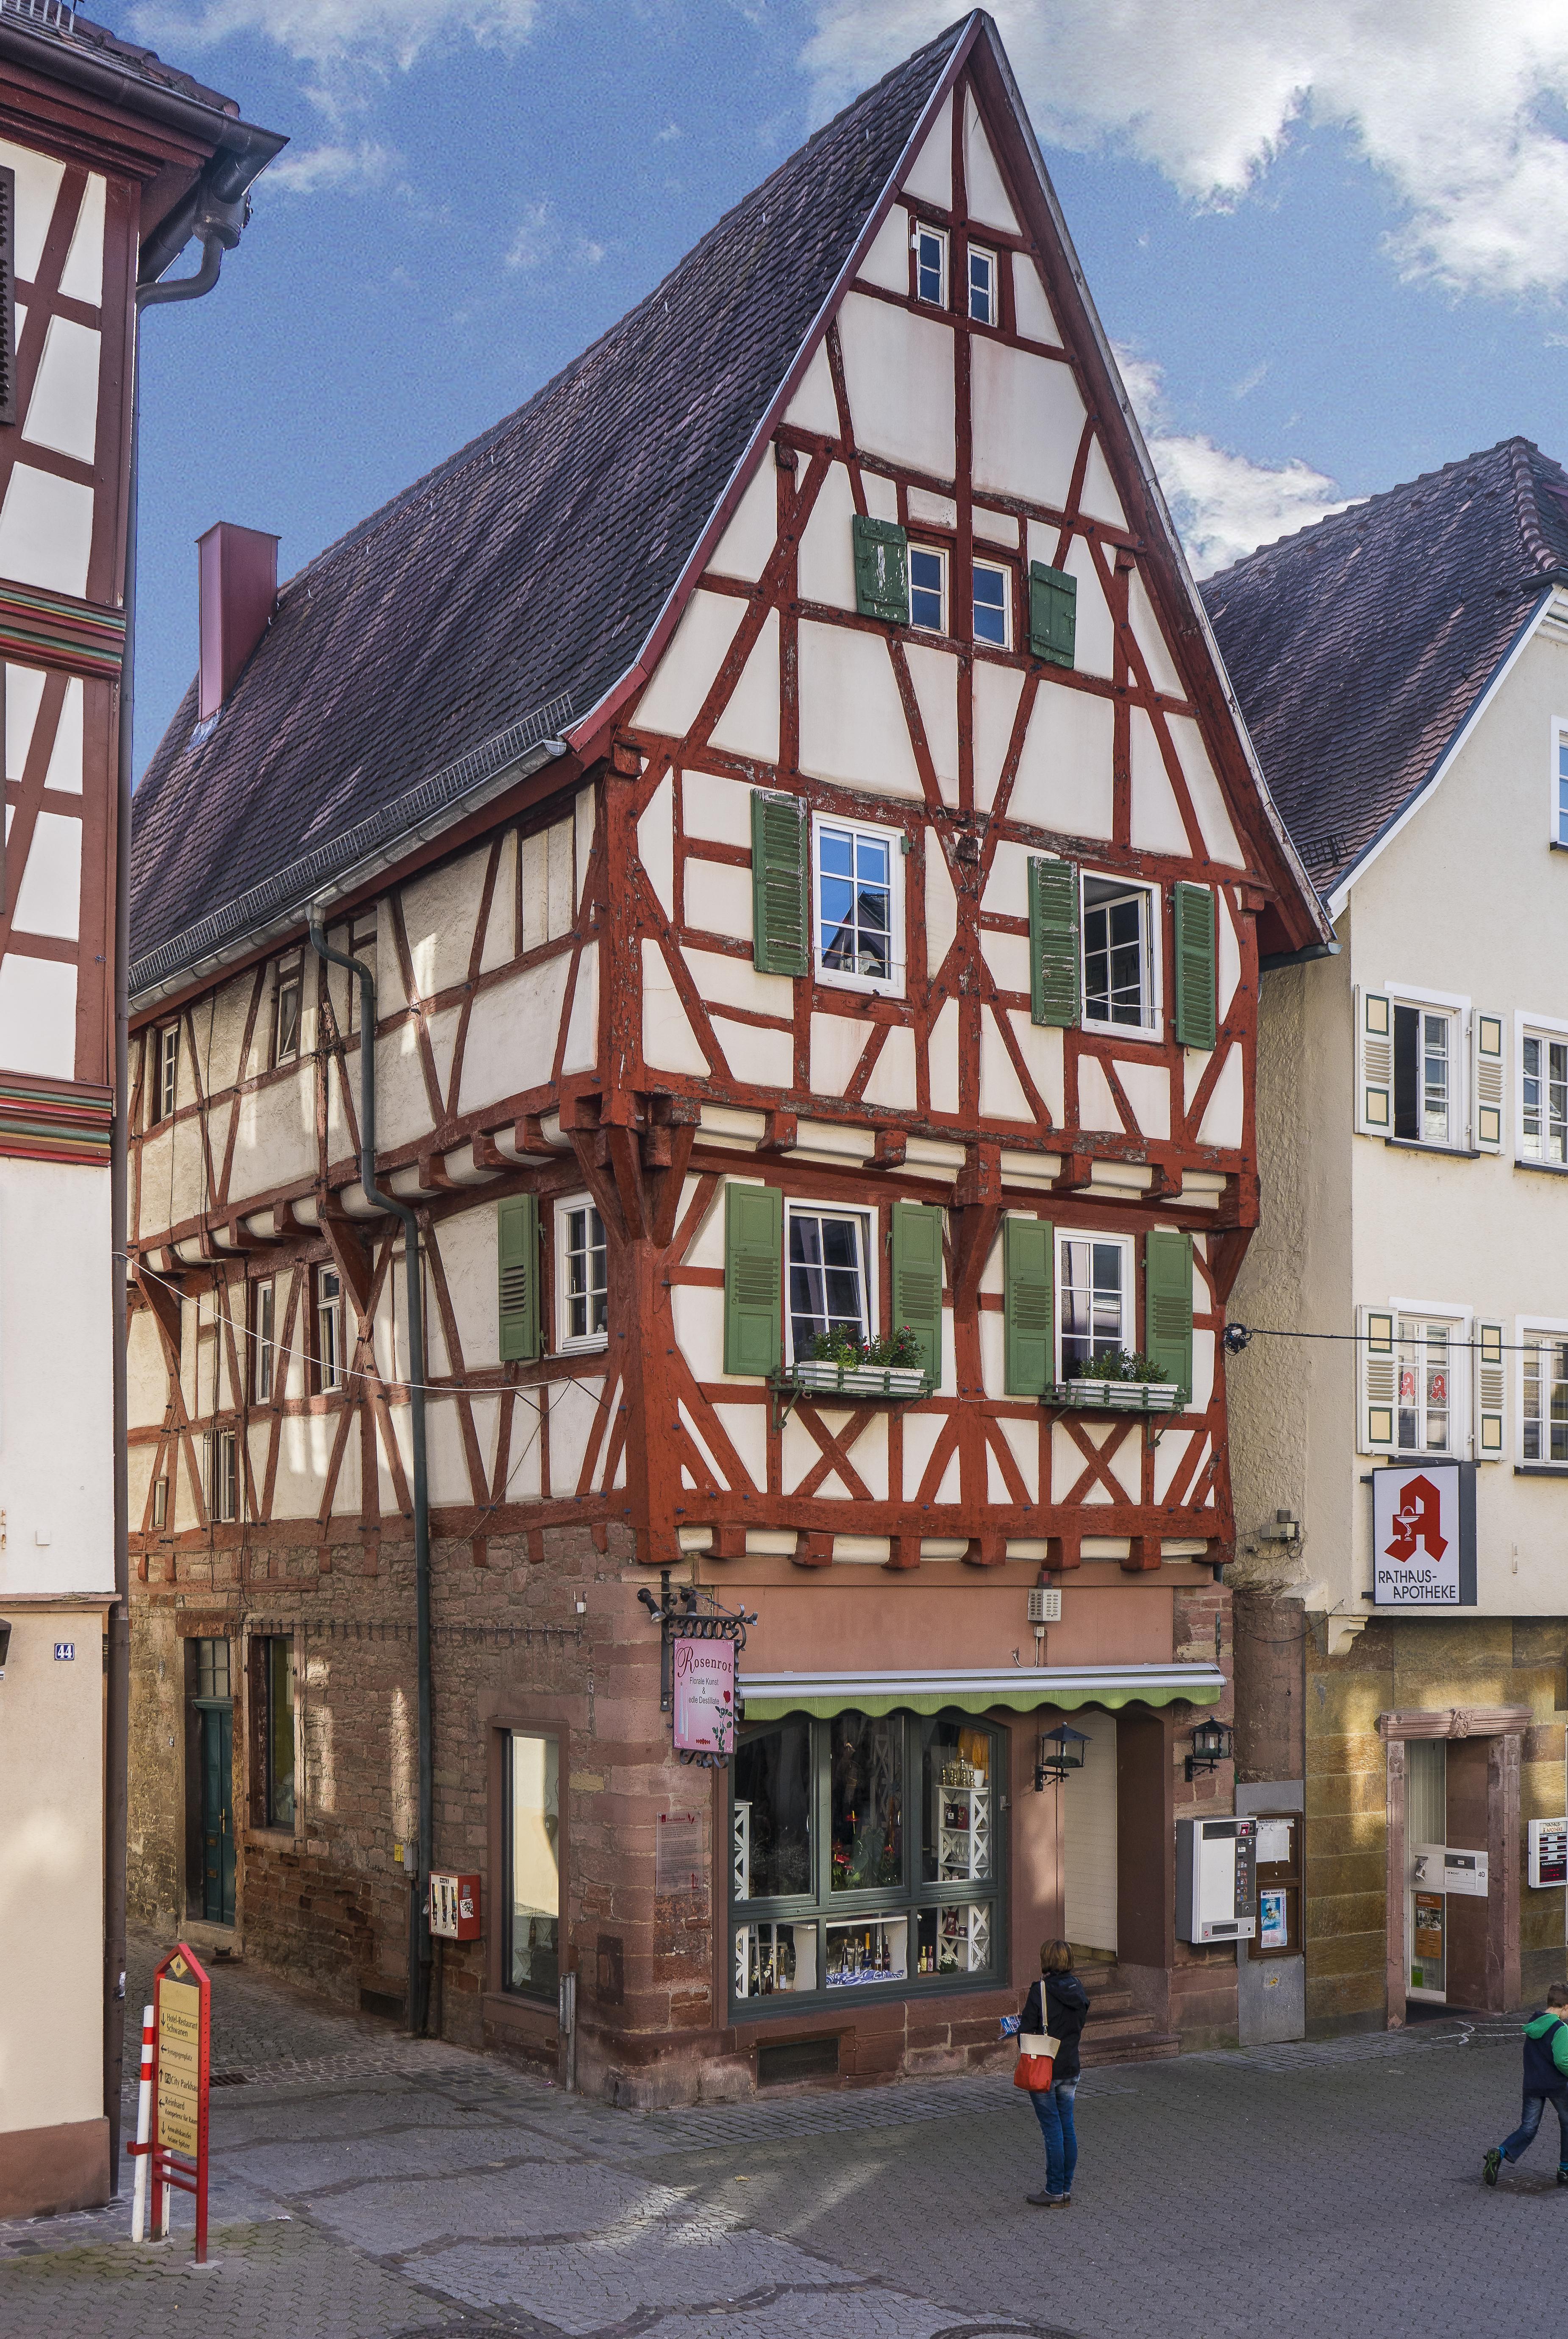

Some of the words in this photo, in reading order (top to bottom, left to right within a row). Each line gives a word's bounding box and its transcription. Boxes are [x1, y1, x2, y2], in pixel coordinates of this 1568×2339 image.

[1378, 1569, 1437, 1583] RATHAUS-
[1393, 1585, 1456, 1599] APOTHEKE
[58, 1645, 72, 1658] 44
[676, 1645, 732, 1677] Rosenrot
[689, 1677, 704, 1685] Florale
[706, 1677, 719, 1685] Kunst
[699, 1696, 720, 1705] Destillate
[167, 2013, 198, 2030] Hotel-Restaurant
[167, 2023, 188, 2037] Schwanen
[171, 2075, 180, 2089] City
[181, 2079, 198, 2092] Parkhau
[165, 2096, 185, 2111] Reinhard
